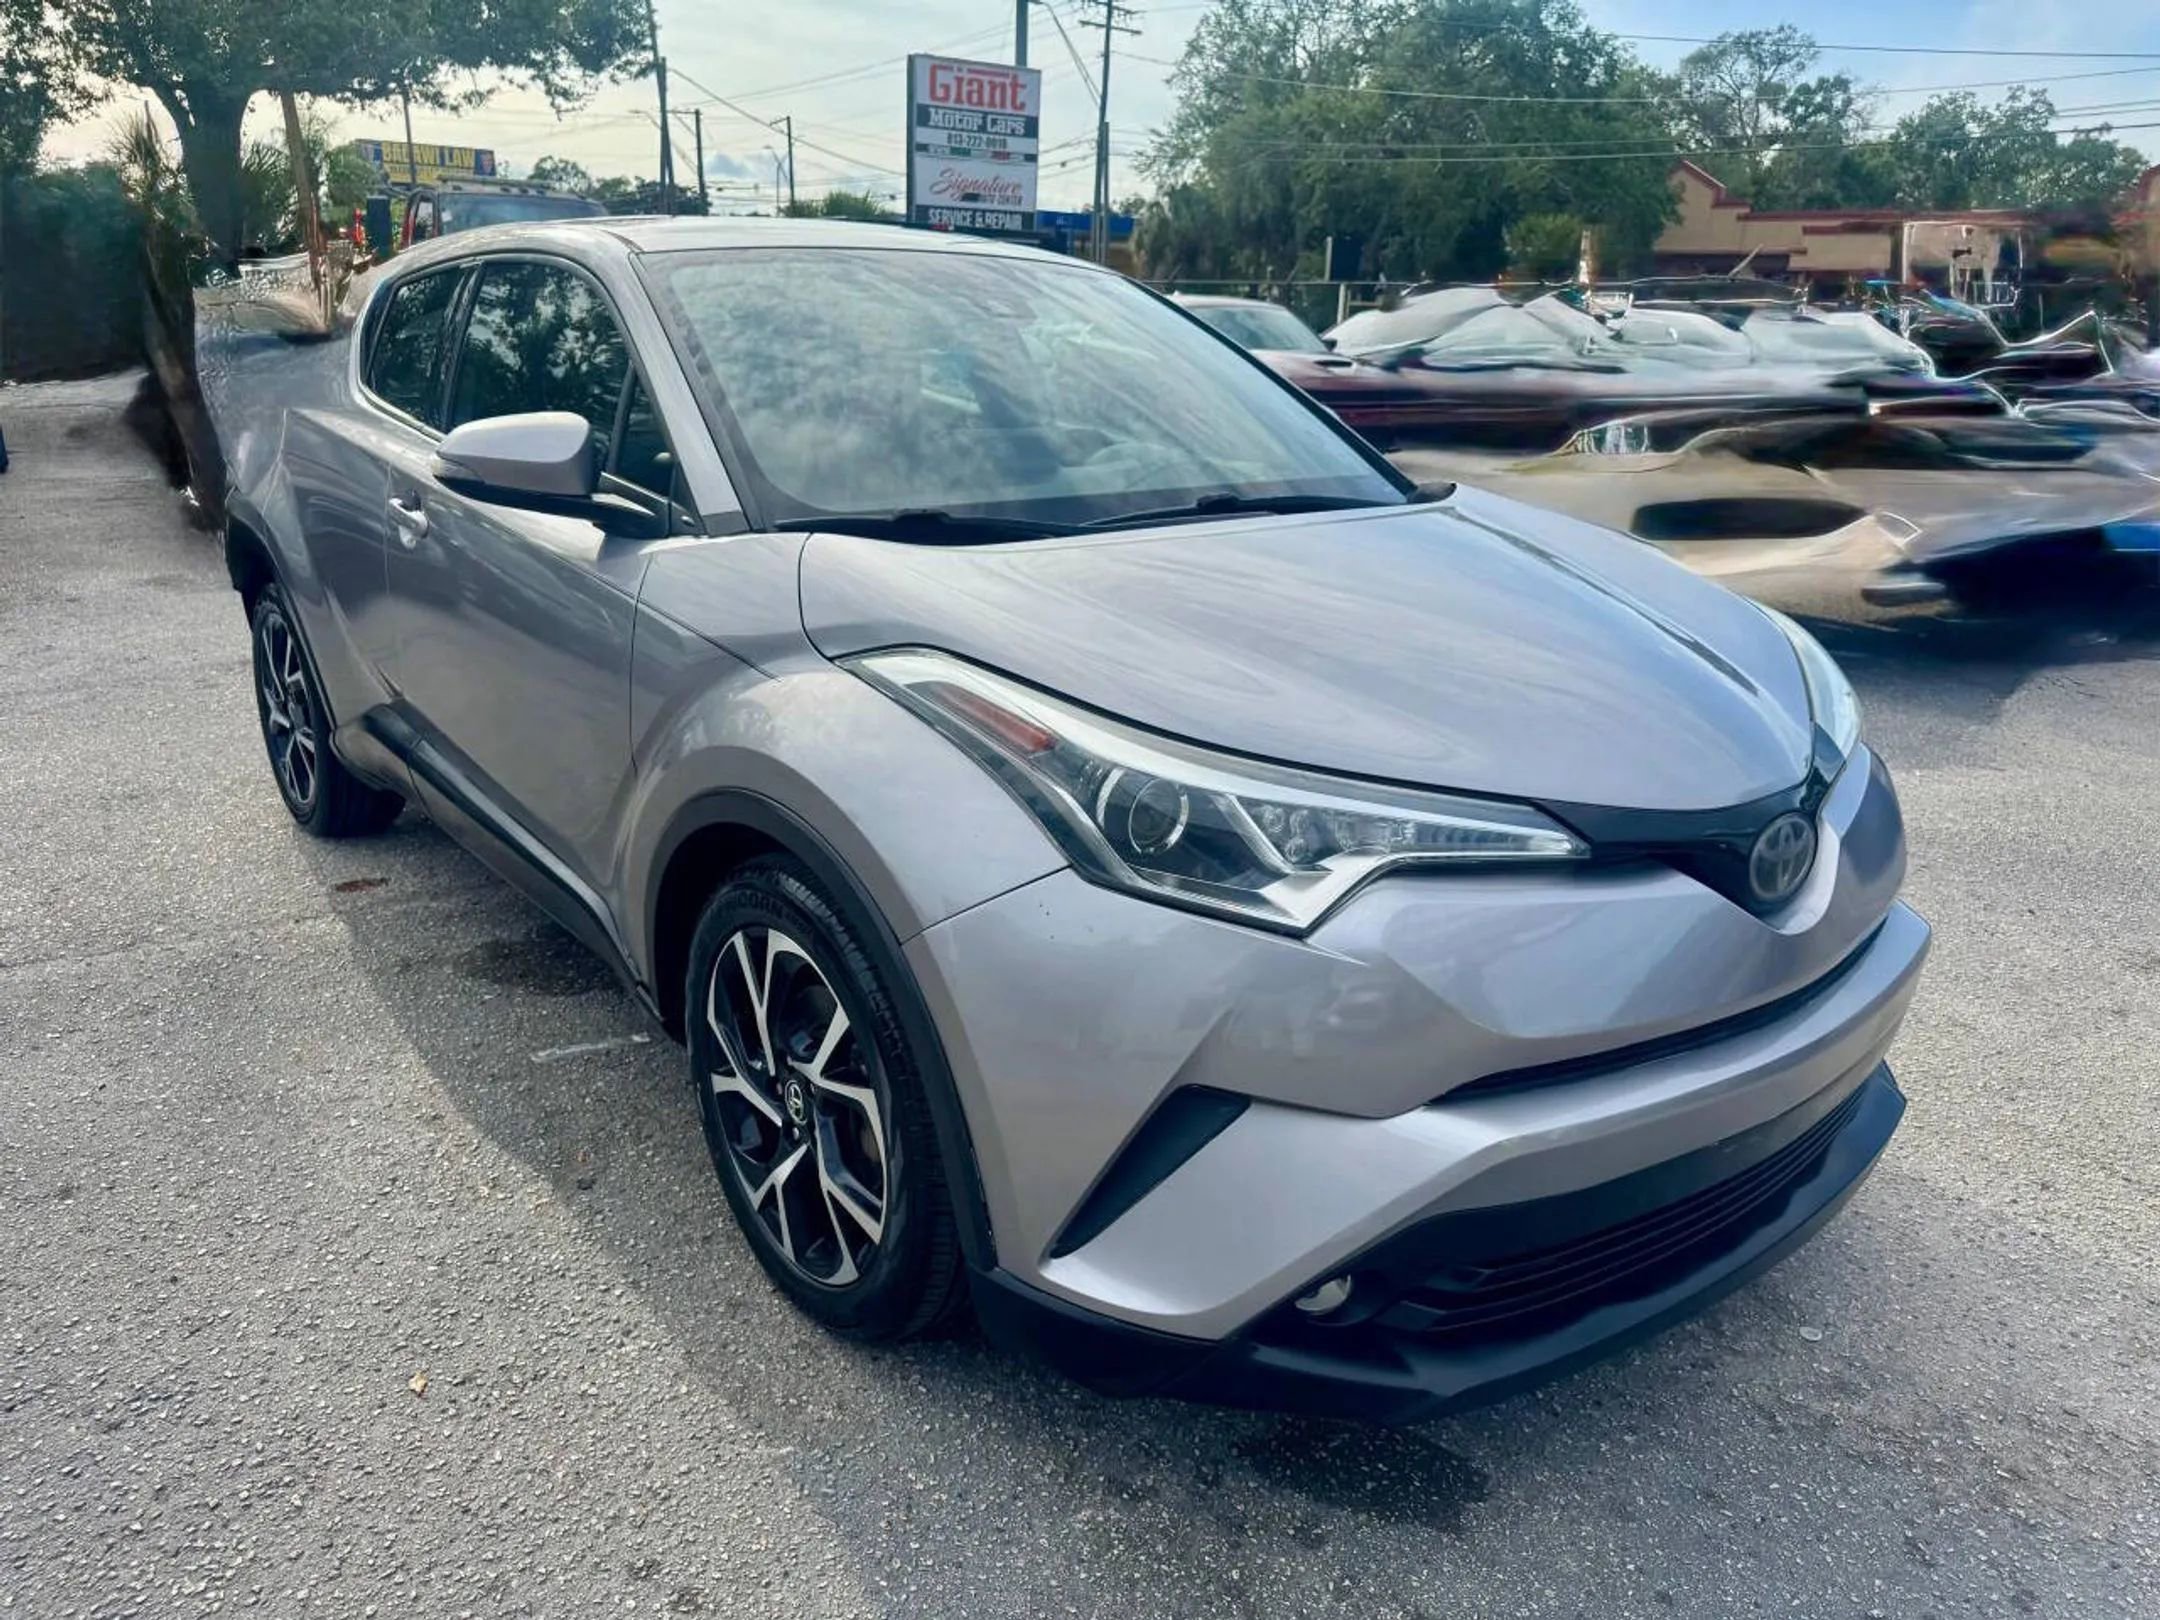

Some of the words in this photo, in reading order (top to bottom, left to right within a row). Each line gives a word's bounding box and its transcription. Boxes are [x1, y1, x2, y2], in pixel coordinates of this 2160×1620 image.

[929, 64, 1027, 111] Giant
[928, 107, 983, 132] Motor
[987, 114, 1026, 136] Cars
[445, 147, 475, 168] LAW
[930, 168, 1022, 201] Signature
[927, 207, 974, 227] SERVICE
[985, 211, 1023, 231] REPAIR
